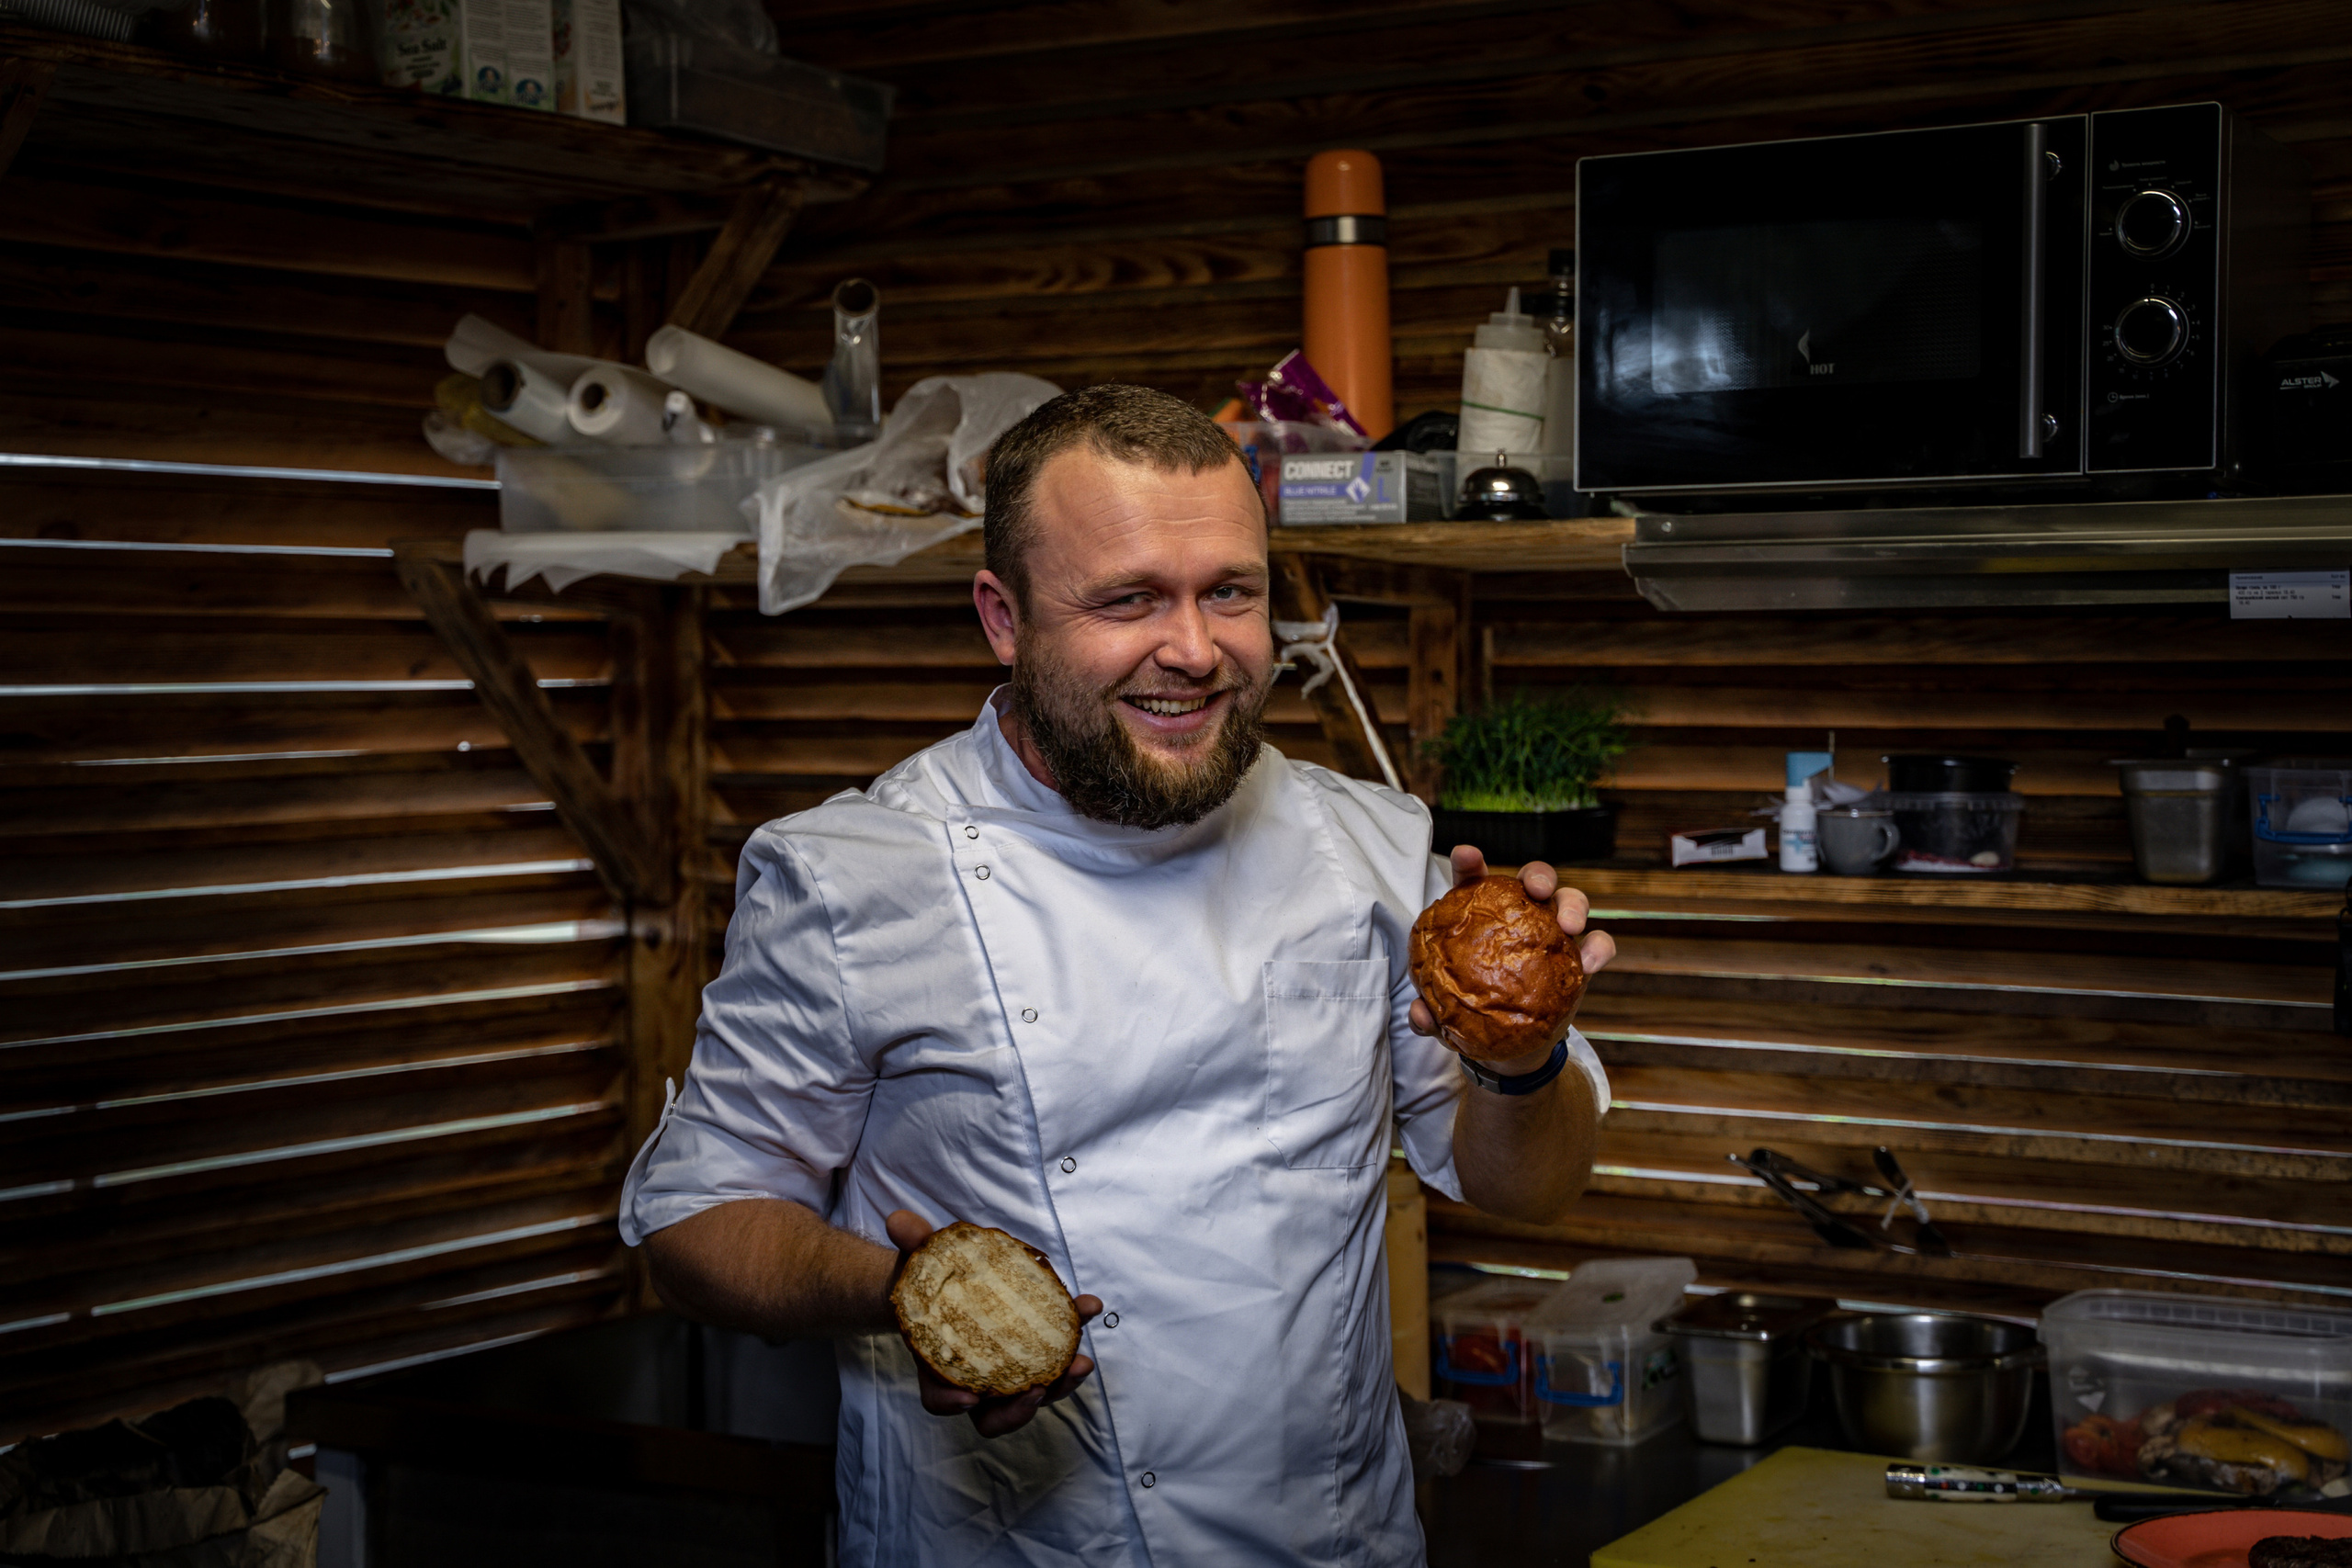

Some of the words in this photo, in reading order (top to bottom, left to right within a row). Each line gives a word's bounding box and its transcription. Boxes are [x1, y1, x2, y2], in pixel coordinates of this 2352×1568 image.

[397, 42, 420, 55] Sea
[422, 37, 447, 52] Salt
[2280, 376, 2322, 386] ALSTER
[1283, 460, 1354, 480] CONNECT
[1284, 486, 1305, 497] BLUE
[1305, 485, 1337, 496] NITRILE
[1377, 477, 1390, 502] L
